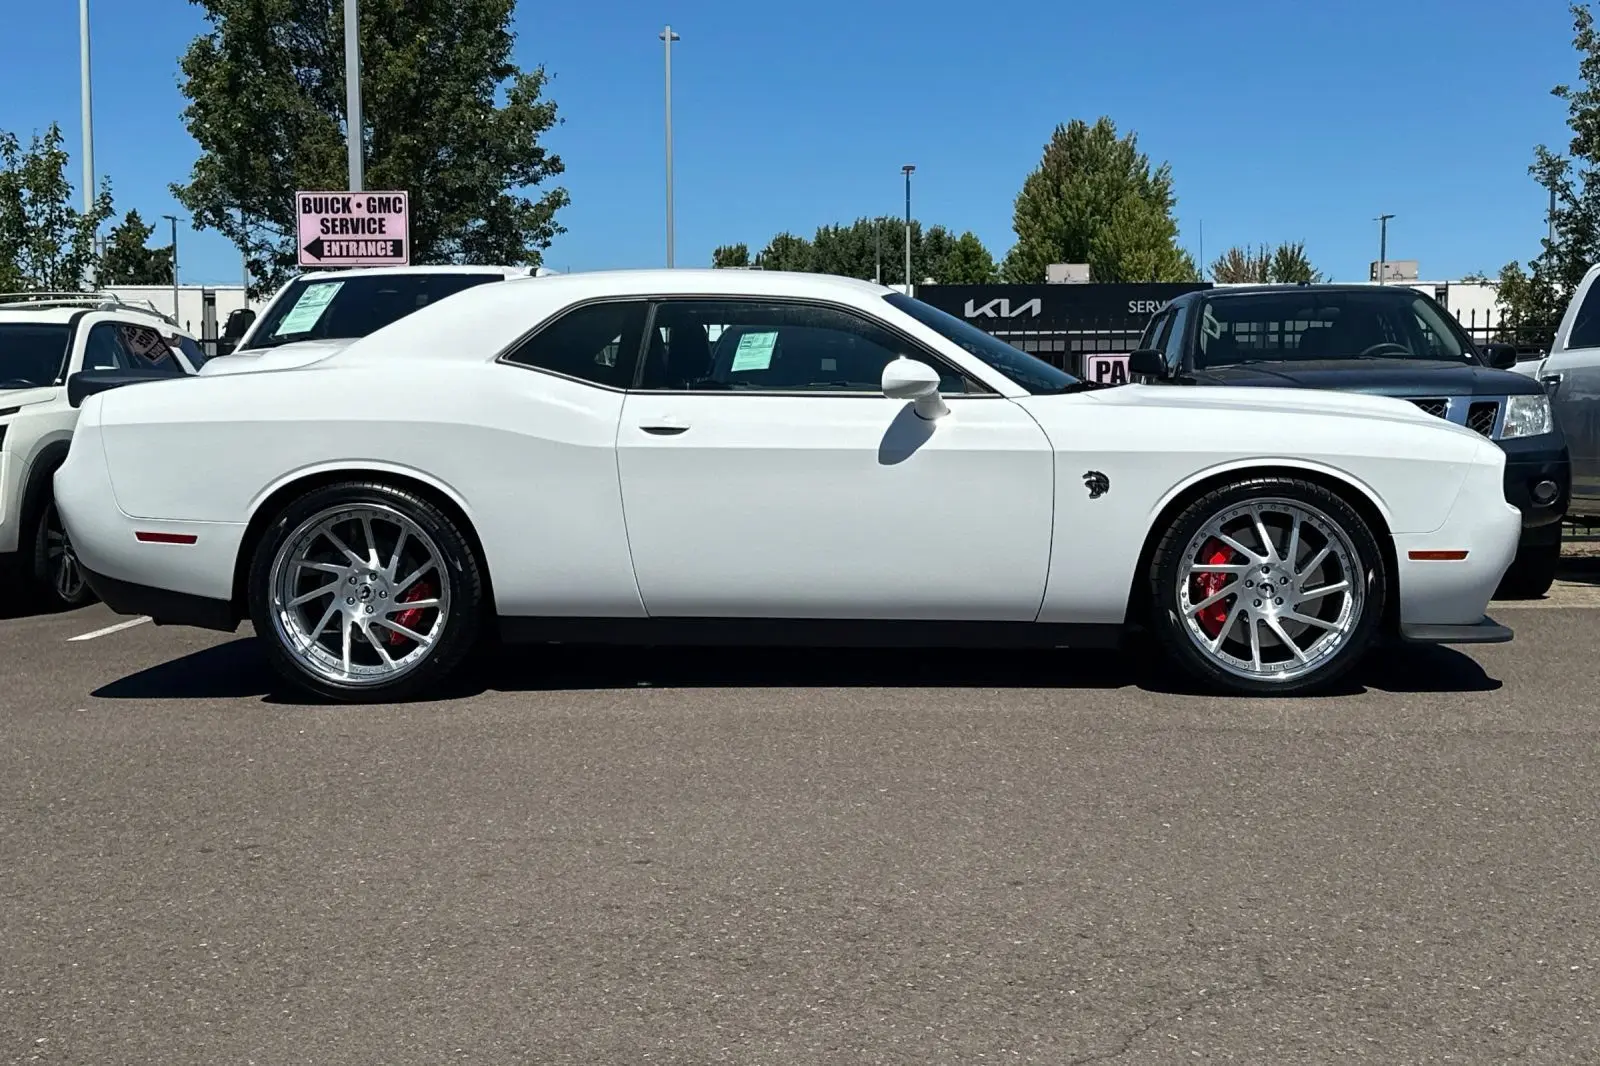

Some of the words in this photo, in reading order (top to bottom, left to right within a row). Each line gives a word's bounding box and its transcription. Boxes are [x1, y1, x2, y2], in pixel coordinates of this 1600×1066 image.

[302, 197, 352, 214] BUICK
[366, 196, 403, 214] GMC
[320, 217, 387, 235] SERVICE
[323, 241, 394, 256] ENTRANCE
[964, 298, 1042, 318] KIA
[1096, 360, 1130, 384] PA
